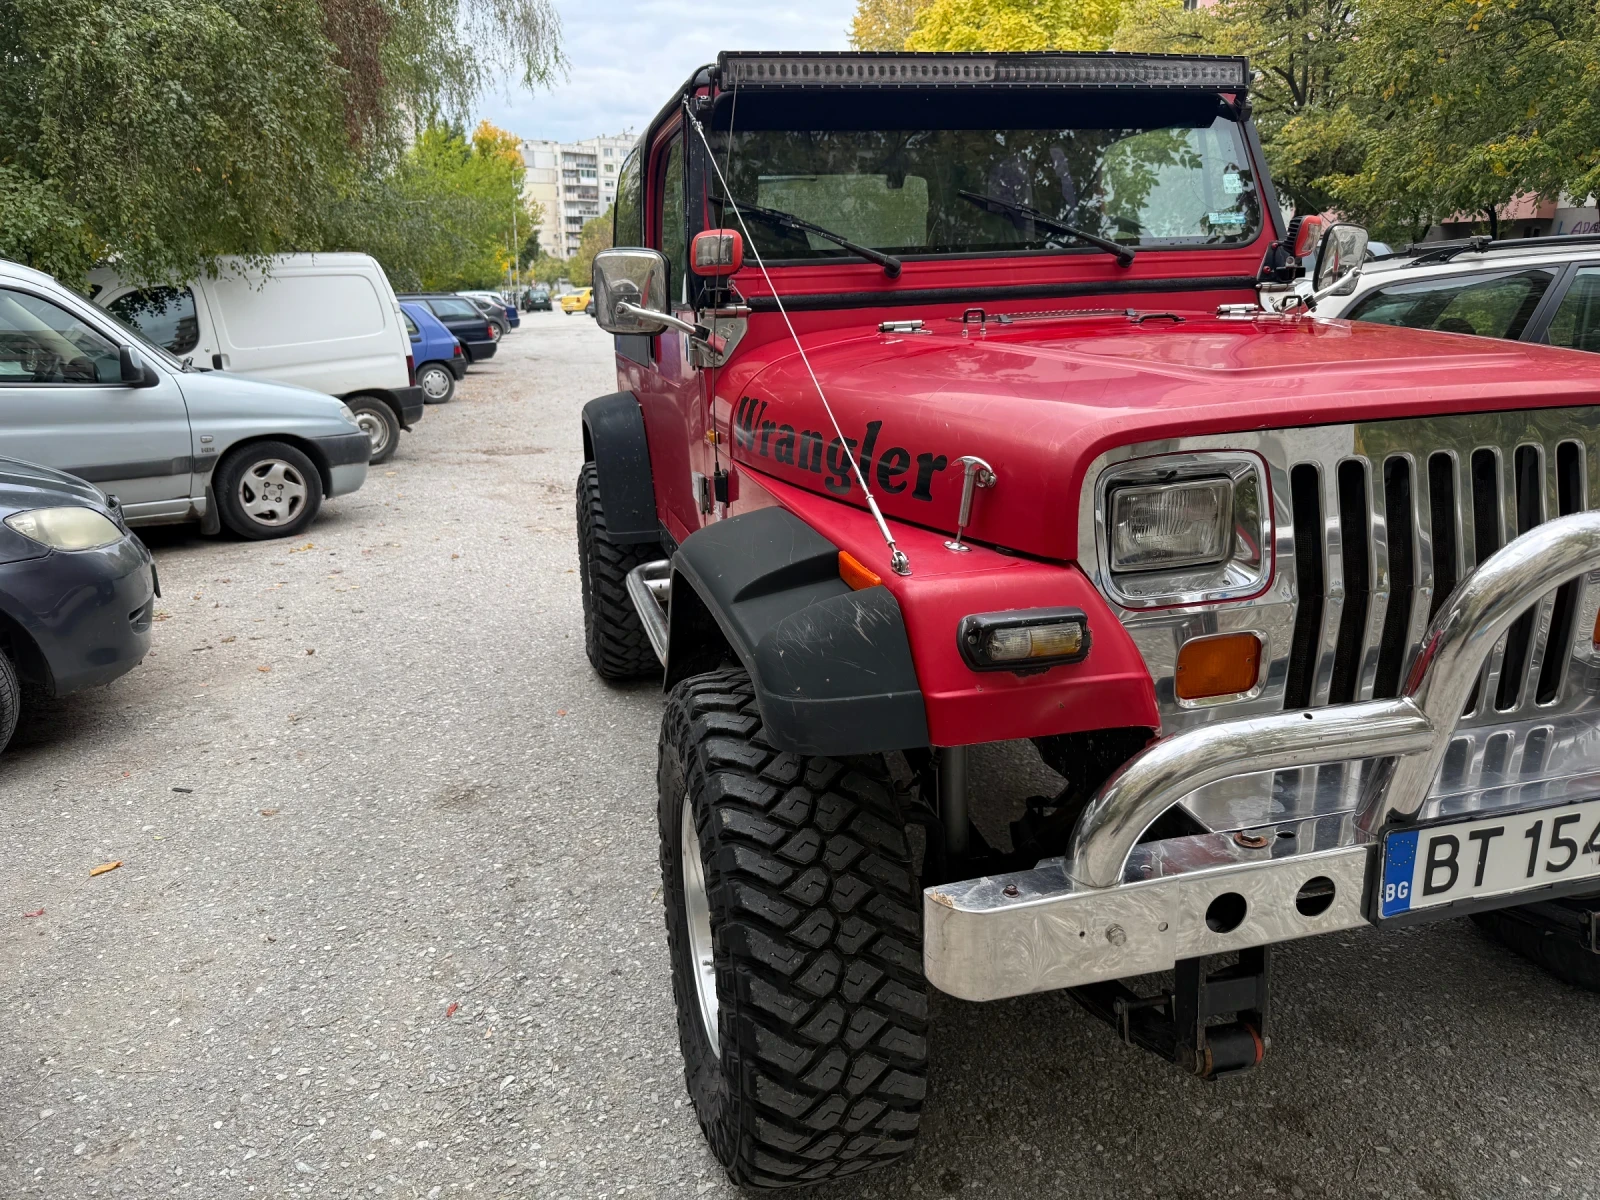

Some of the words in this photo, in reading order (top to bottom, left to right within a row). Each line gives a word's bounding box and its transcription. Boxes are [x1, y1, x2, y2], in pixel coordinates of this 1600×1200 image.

[734, 396, 948, 502] Wrangler
[1385, 881, 1409, 903] BG
[1422, 826, 1505, 897] BT
